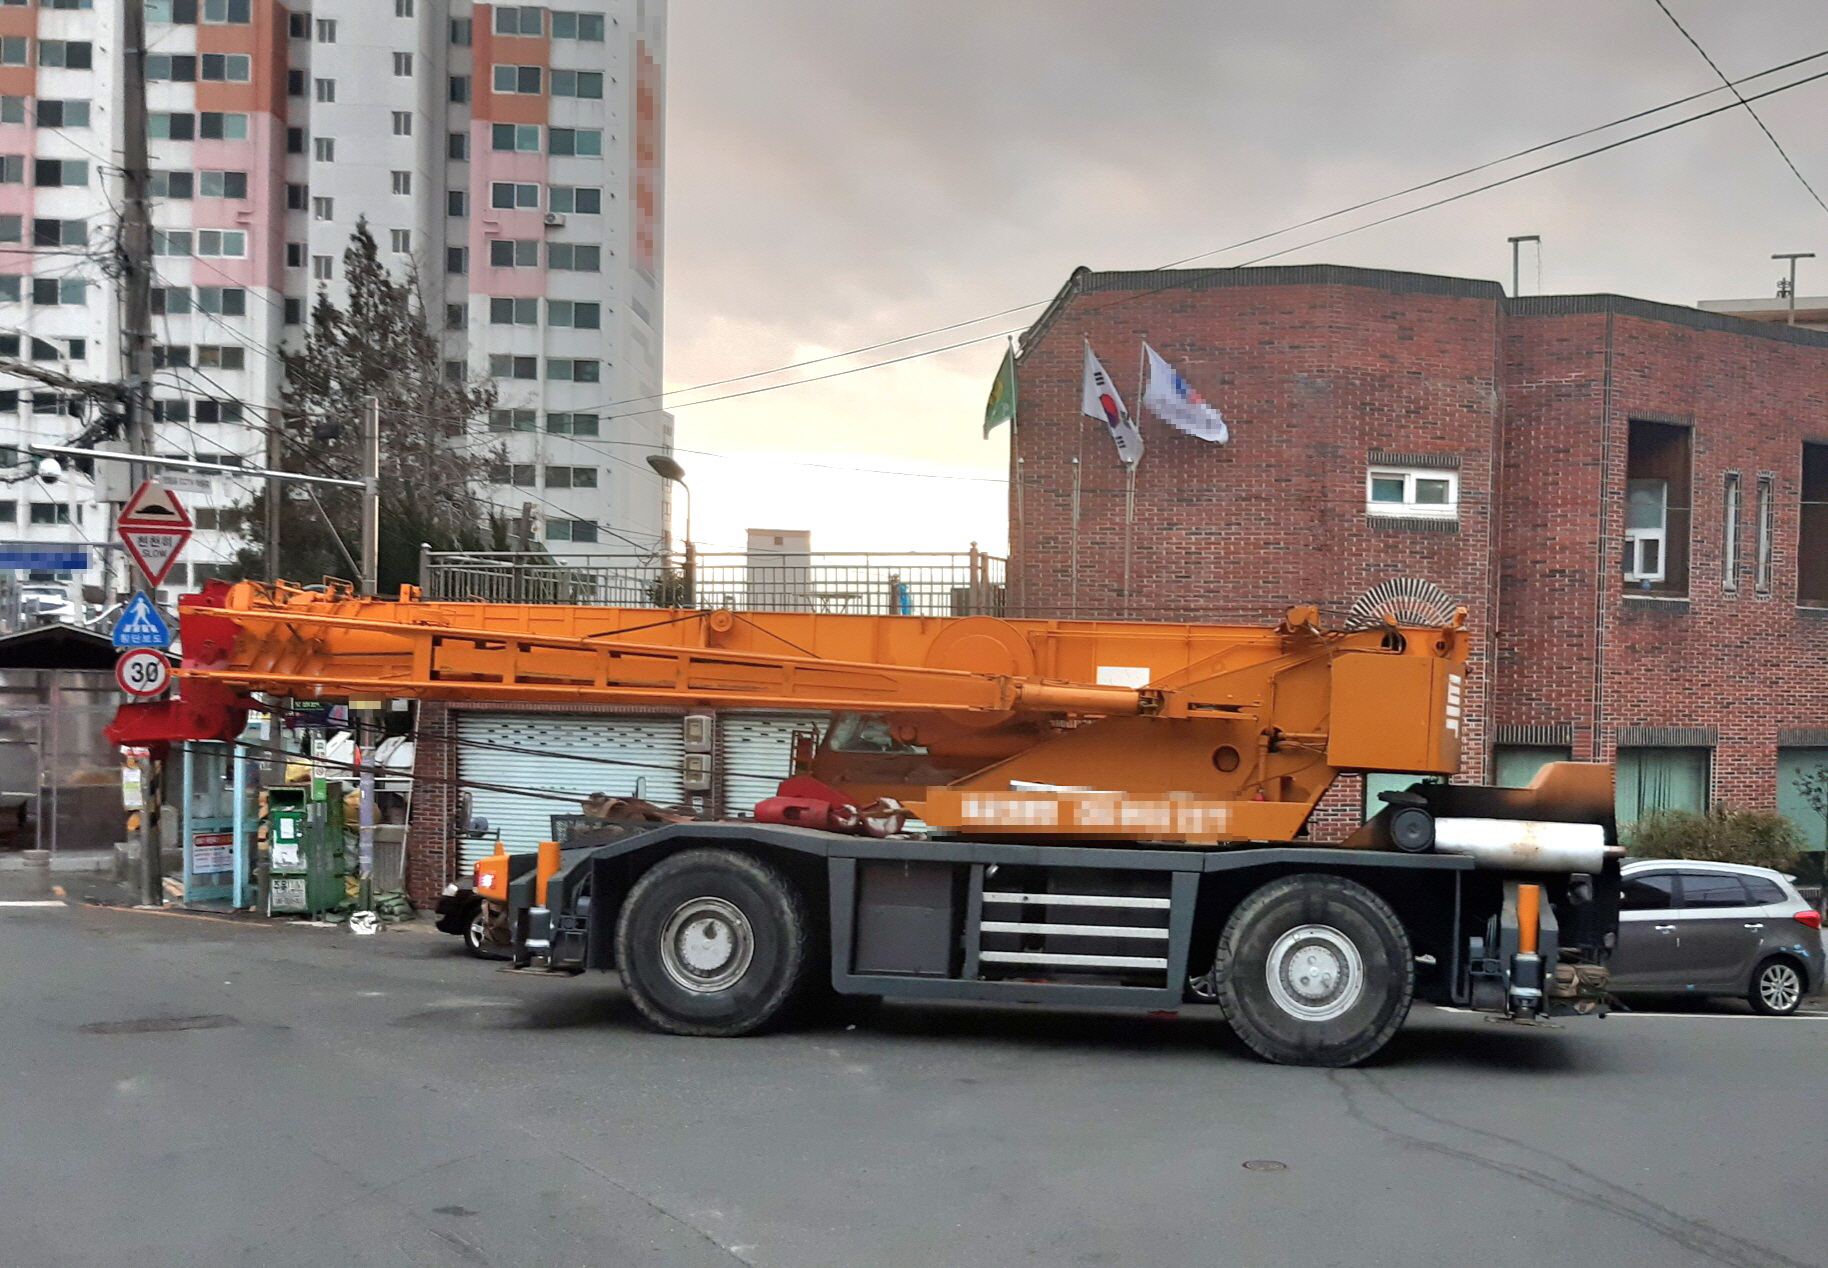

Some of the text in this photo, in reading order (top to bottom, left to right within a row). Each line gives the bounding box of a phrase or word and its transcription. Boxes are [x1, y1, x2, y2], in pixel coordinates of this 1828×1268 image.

[137, 535, 173, 548] 천천히
[142, 548, 168, 558] SLOW
[120, 633, 163, 644] 횡단보도
[131, 662, 158, 683] 30
